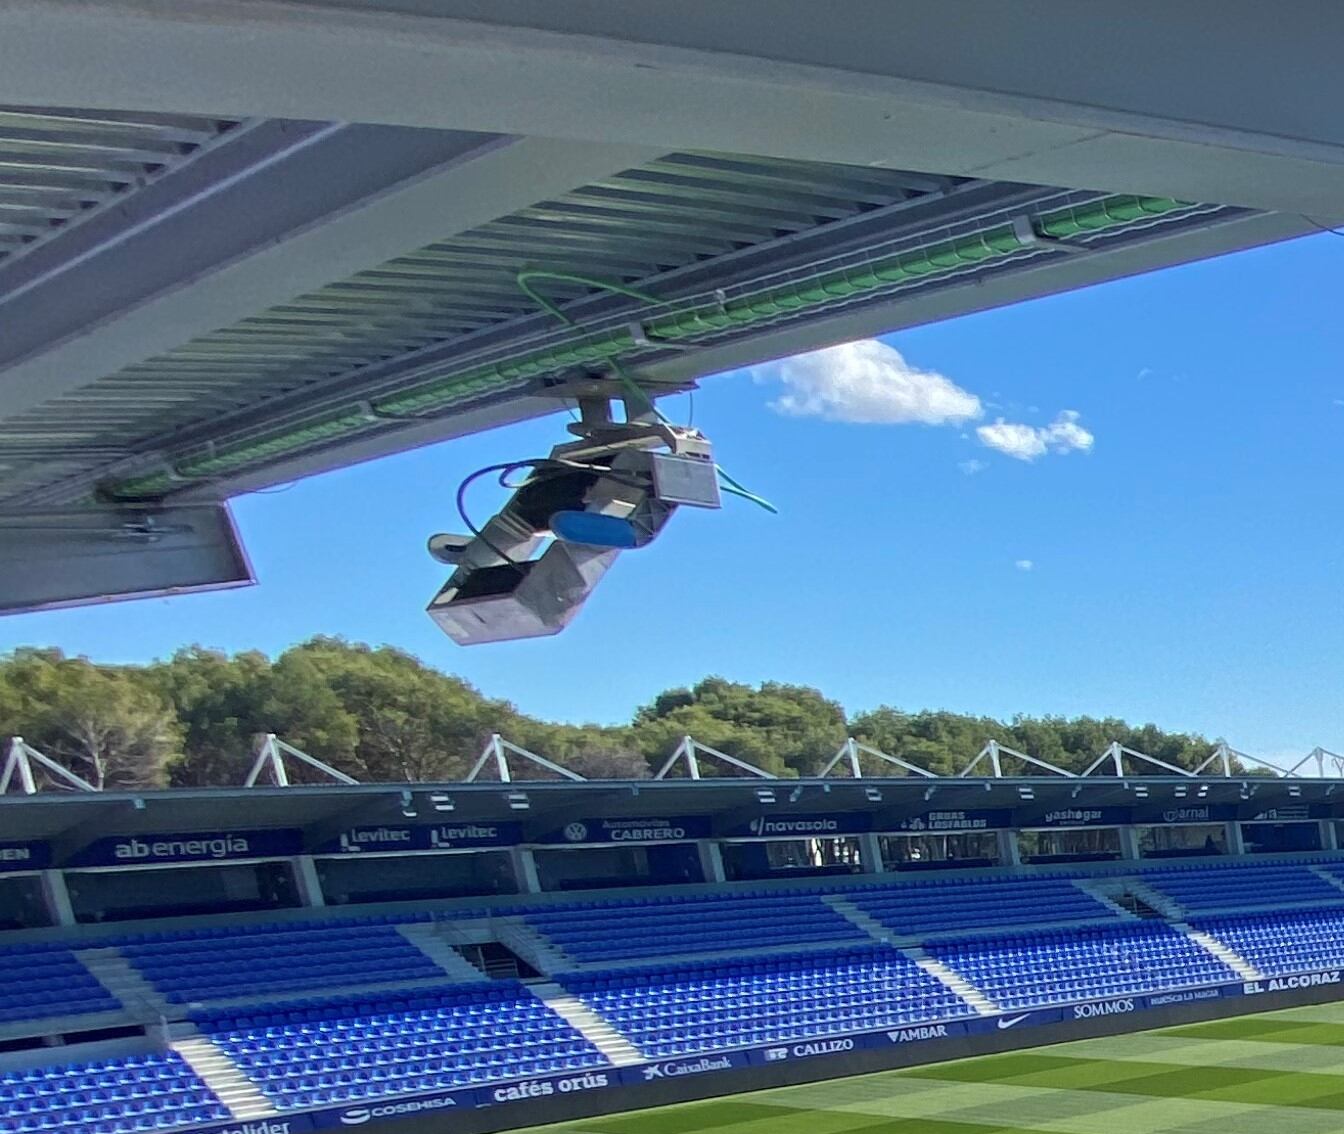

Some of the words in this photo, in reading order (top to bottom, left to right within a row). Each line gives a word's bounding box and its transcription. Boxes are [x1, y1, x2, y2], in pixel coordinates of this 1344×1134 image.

[1178, 806, 1209, 818] arnal
[441, 825, 498, 840] Levitec
[611, 828, 689, 841] CABRERO
[764, 818, 838, 833] navasola
[351, 828, 411, 843] Levitec
[115, 834, 249, 858] abenergía
[1243, 982, 1264, 995] EL
[1268, 971, 1341, 991] ALCORAZ
[1074, 999, 1135, 1020] SOMMOS
[900, 1025, 947, 1042] AMBAR
[793, 1039, 854, 1057] CALLIZO
[664, 1055, 732, 1077] CaixaBank
[493, 1078, 554, 1103] cafés
[560, 1072, 609, 1094] orús
[371, 1097, 457, 1118] COSEHISA
